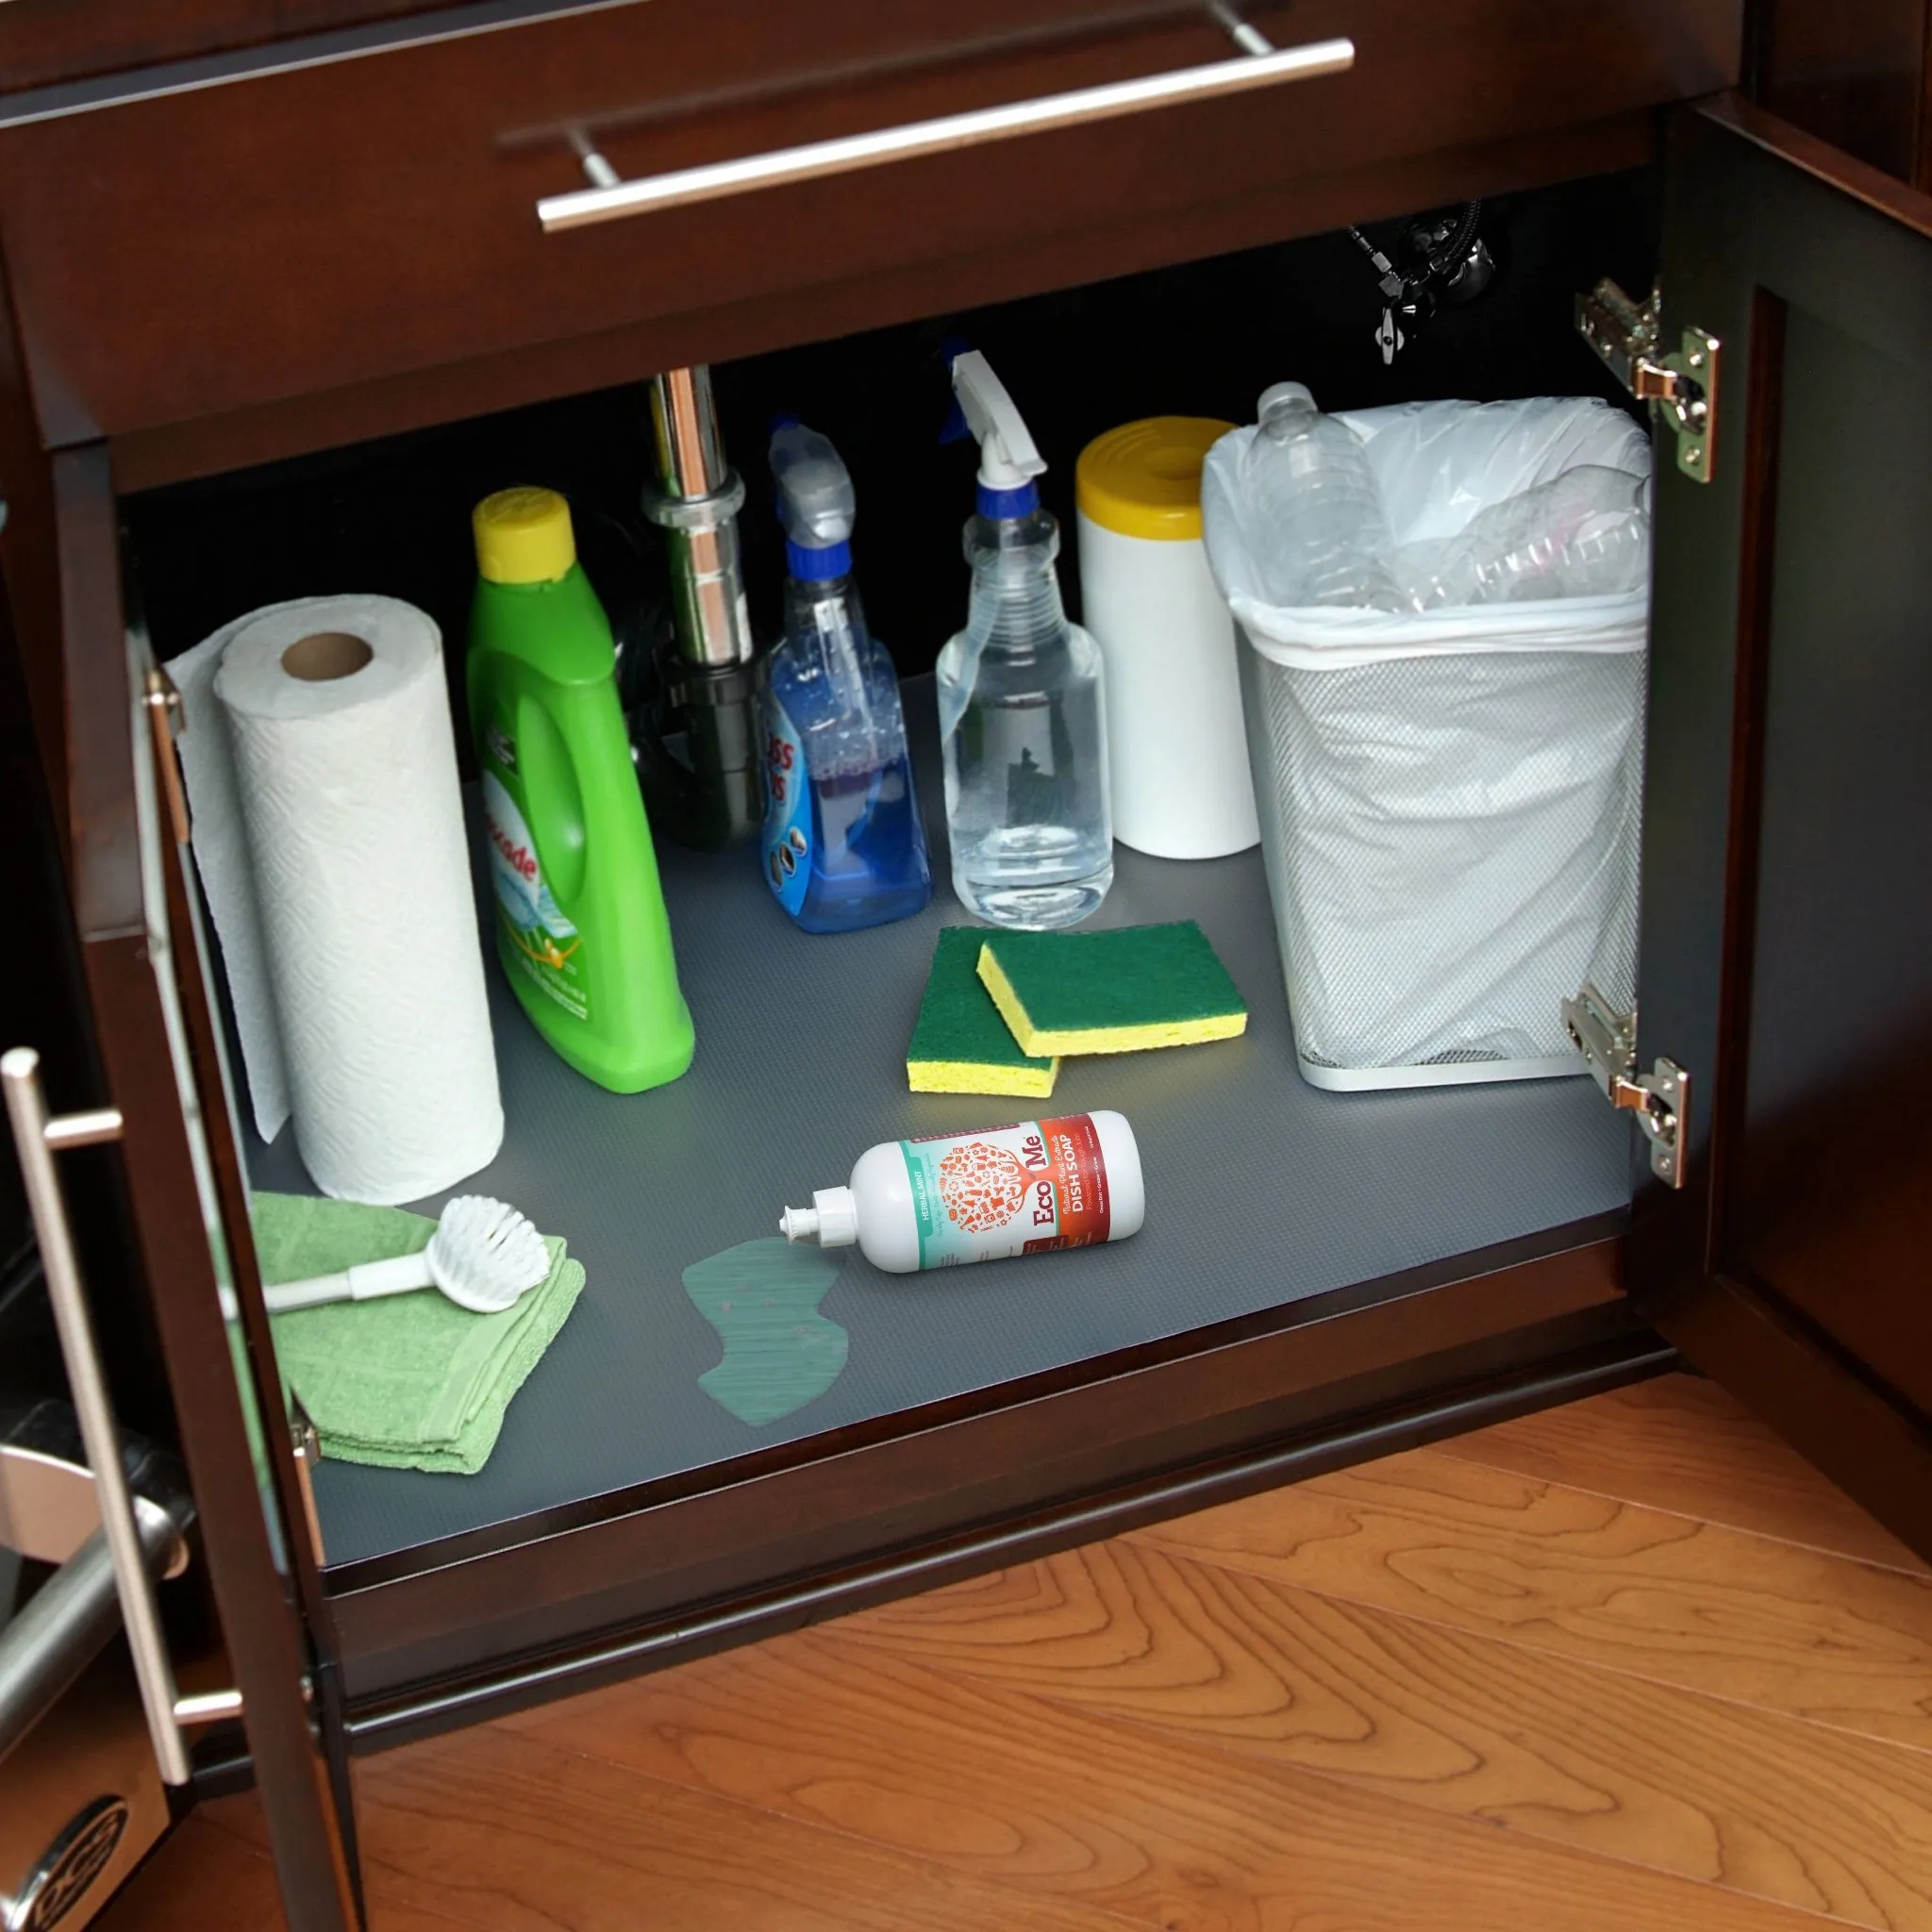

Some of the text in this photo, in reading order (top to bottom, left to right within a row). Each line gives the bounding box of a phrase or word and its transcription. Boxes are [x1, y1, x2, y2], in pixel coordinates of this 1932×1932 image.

[1022, 1135, 1047, 1170] Me
[1059, 1134, 1078, 1171] SOAP
[1058, 1160, 1067, 1183] Plant
[914, 1170, 929, 1221] HERBAL MINT
[1033, 1180, 1054, 1226] Eco
[1070, 1174, 1083, 1212] DISH
